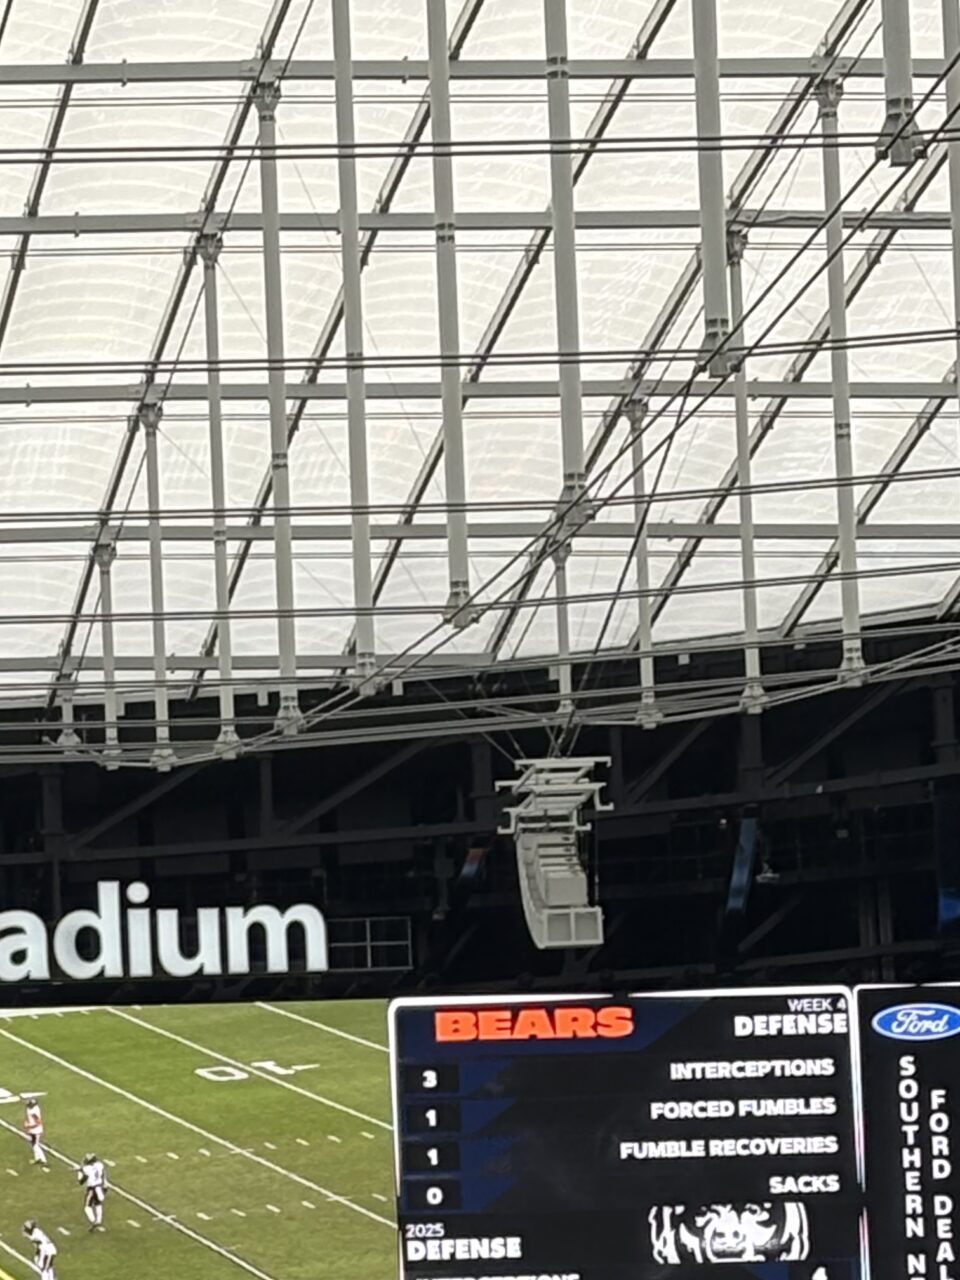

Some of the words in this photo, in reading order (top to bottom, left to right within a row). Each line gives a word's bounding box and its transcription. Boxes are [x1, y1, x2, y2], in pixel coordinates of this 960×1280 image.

[788, 998, 833, 1012] WEEK
[837, 998, 846, 1011] 4
[435, 1007, 634, 1042] BEARS
[734, 1013, 848, 1036] DEFENSE
[891, 1009, 949, 1033] Ford
[422, 1071, 438, 1088] 3
[670, 1059, 835, 1079] INTERCEPTIONS
[426, 1110, 437, 1126] 1
[651, 1101, 735, 1120] FORCED
[739, 1098, 837, 1117] FUMBLES
[929, 1089, 951, 1180] FORD
[620, 1140, 705, 1160] FUMBLE
[709, 1137, 838, 1157] RECOVERIES
[898, 1055, 925, 1238] SOUTHERN
[427, 1150, 438, 1166] 1
[769, 1176, 840, 1194] SACKS
[426, 1188, 443, 1204] 0
[406, 1223, 444, 1237] 2025
[406, 1237, 522, 1261] DEFENSE
